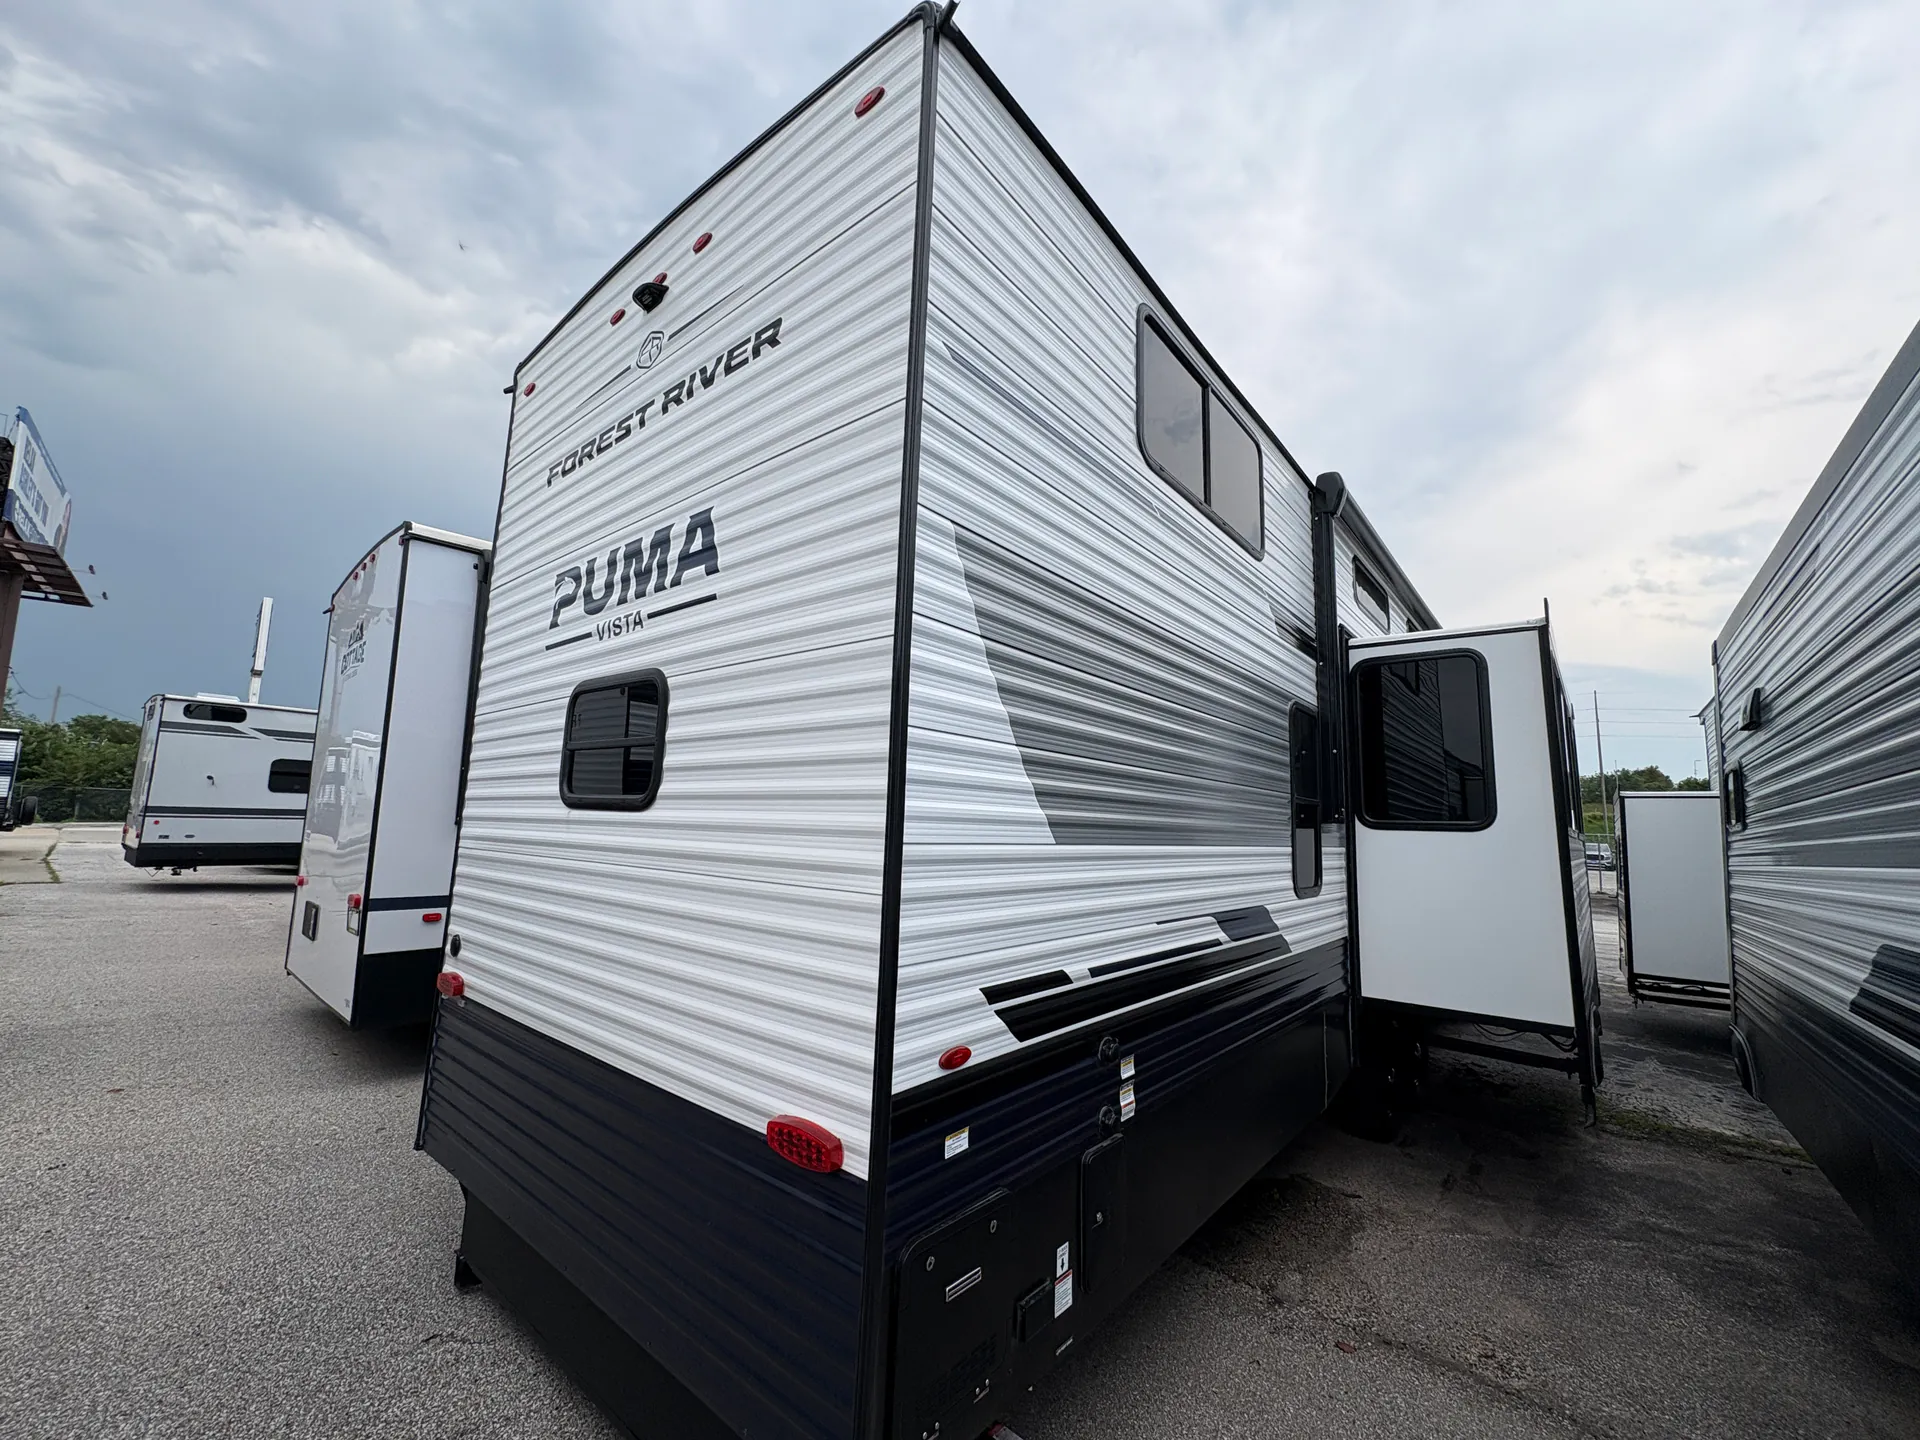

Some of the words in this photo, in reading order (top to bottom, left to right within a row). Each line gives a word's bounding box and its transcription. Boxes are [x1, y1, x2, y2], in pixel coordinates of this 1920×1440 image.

[547, 399, 656, 488] FOREST
[661, 317, 783, 416] RIVER
[549, 506, 721, 630] PUMA
[596, 610, 644, 641] VISTA
